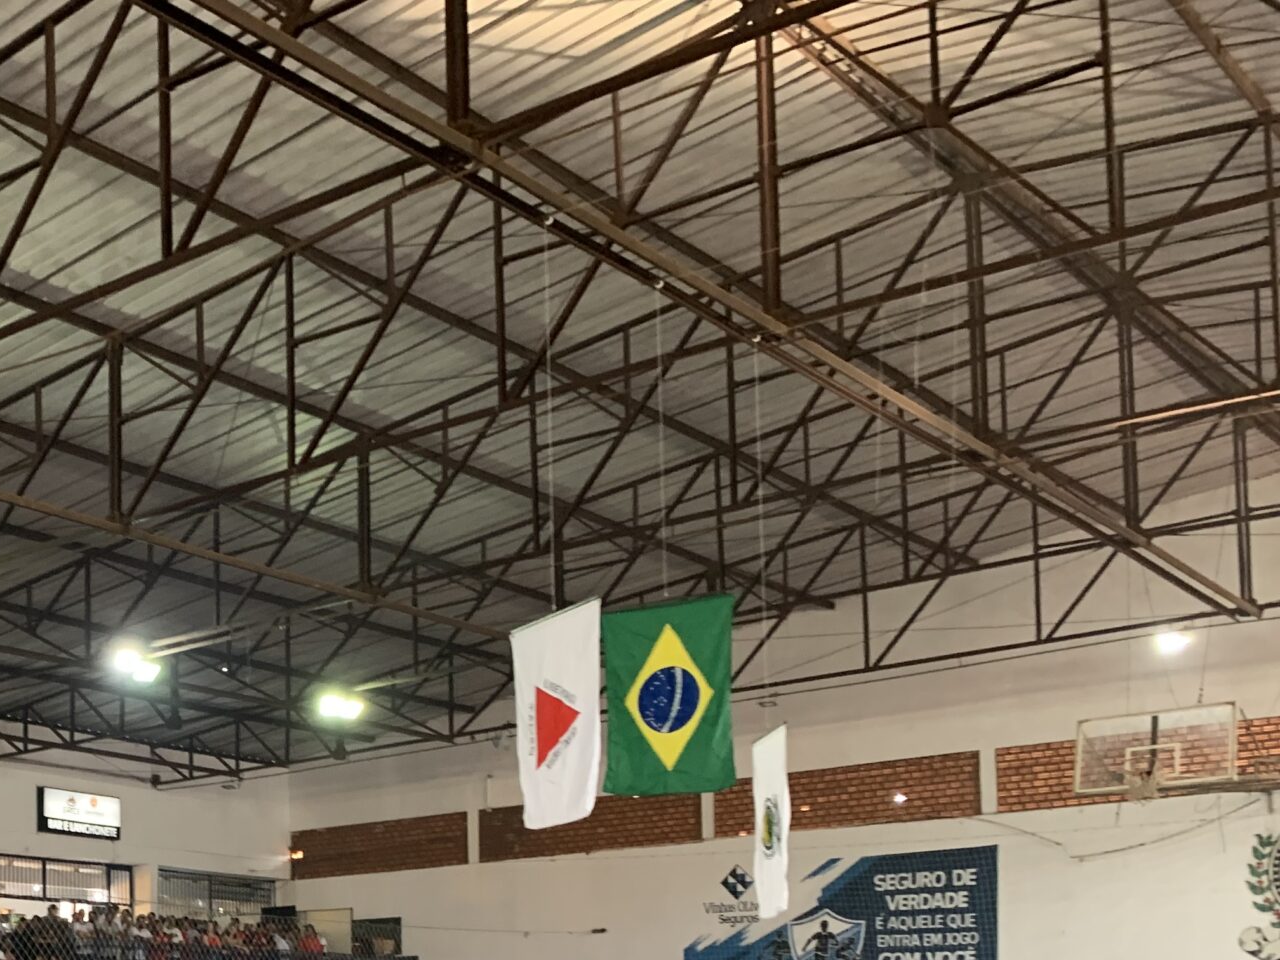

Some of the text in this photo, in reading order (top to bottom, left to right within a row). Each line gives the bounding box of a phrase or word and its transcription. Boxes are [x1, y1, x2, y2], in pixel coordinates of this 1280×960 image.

[873, 868, 977, 891] SEGURO DE
[885, 891, 969, 911] VERDADE
[718, 914, 760, 928] Seguros
[886, 914, 944, 931] AQUELE
[946, 913, 977, 929] QUE
[876, 931, 980, 948] ENTRA EM JOGO
